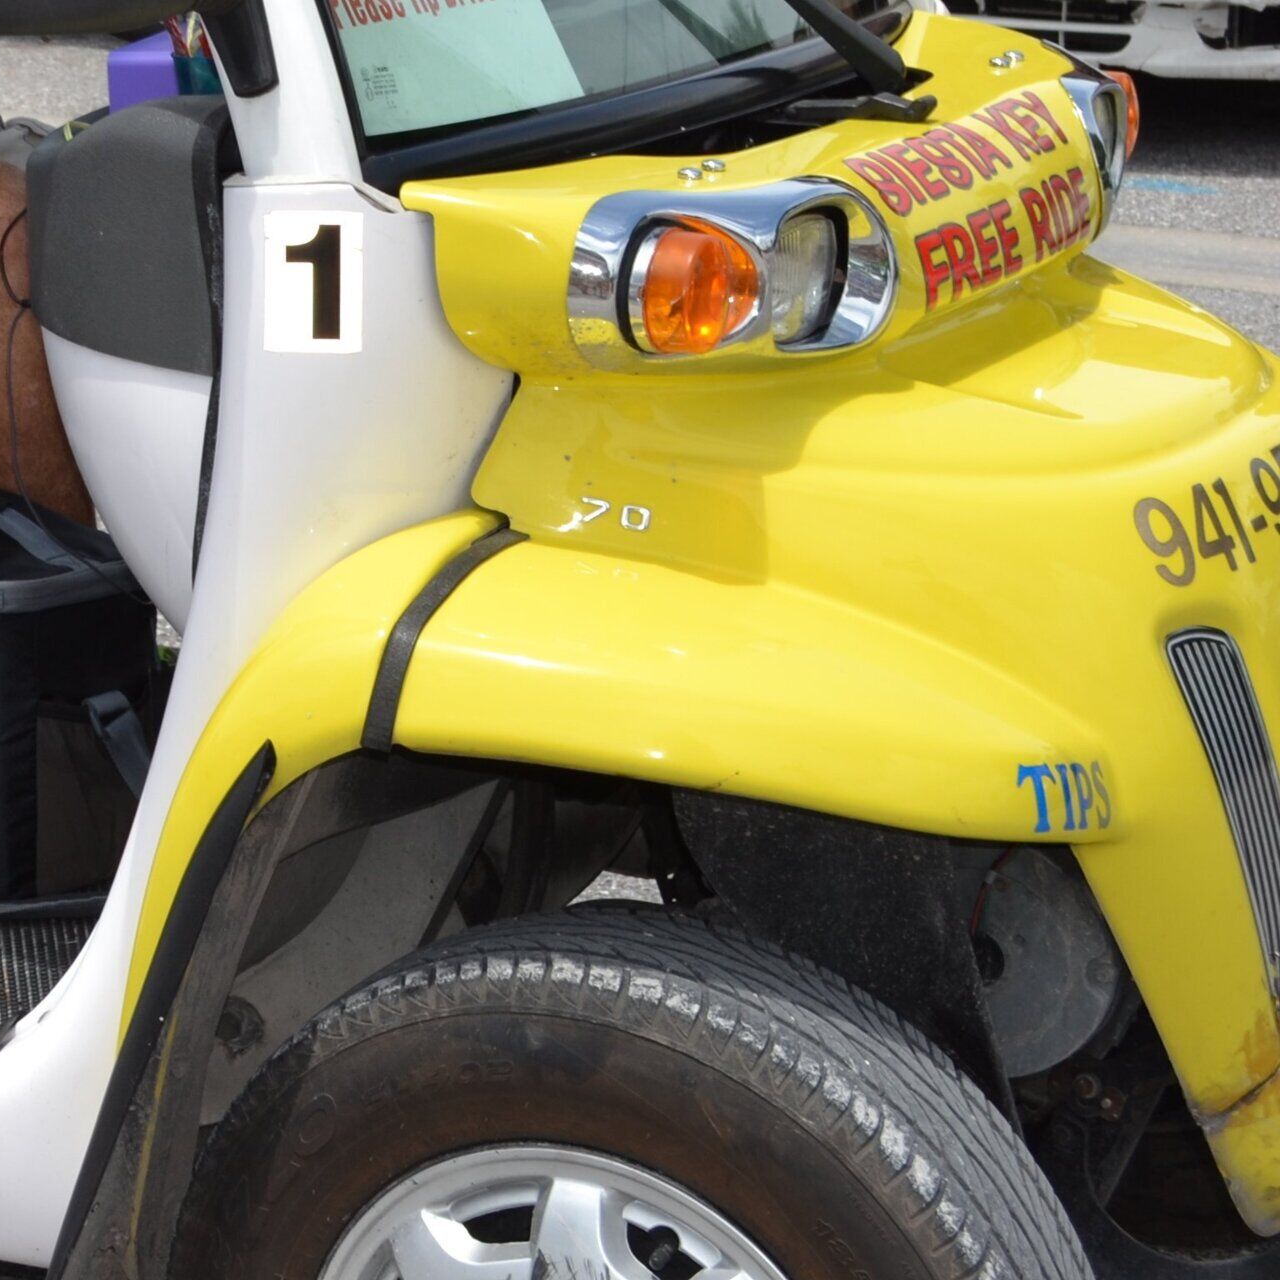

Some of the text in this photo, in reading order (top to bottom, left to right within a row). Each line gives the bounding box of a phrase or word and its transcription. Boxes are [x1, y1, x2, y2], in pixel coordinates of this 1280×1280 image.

[842, 89, 1069, 217] SIESTA KEY
[285, 224, 341, 340] 1
[915, 166, 1094, 313] FREE RIDE
[1016, 759, 1113, 835] TIPS
